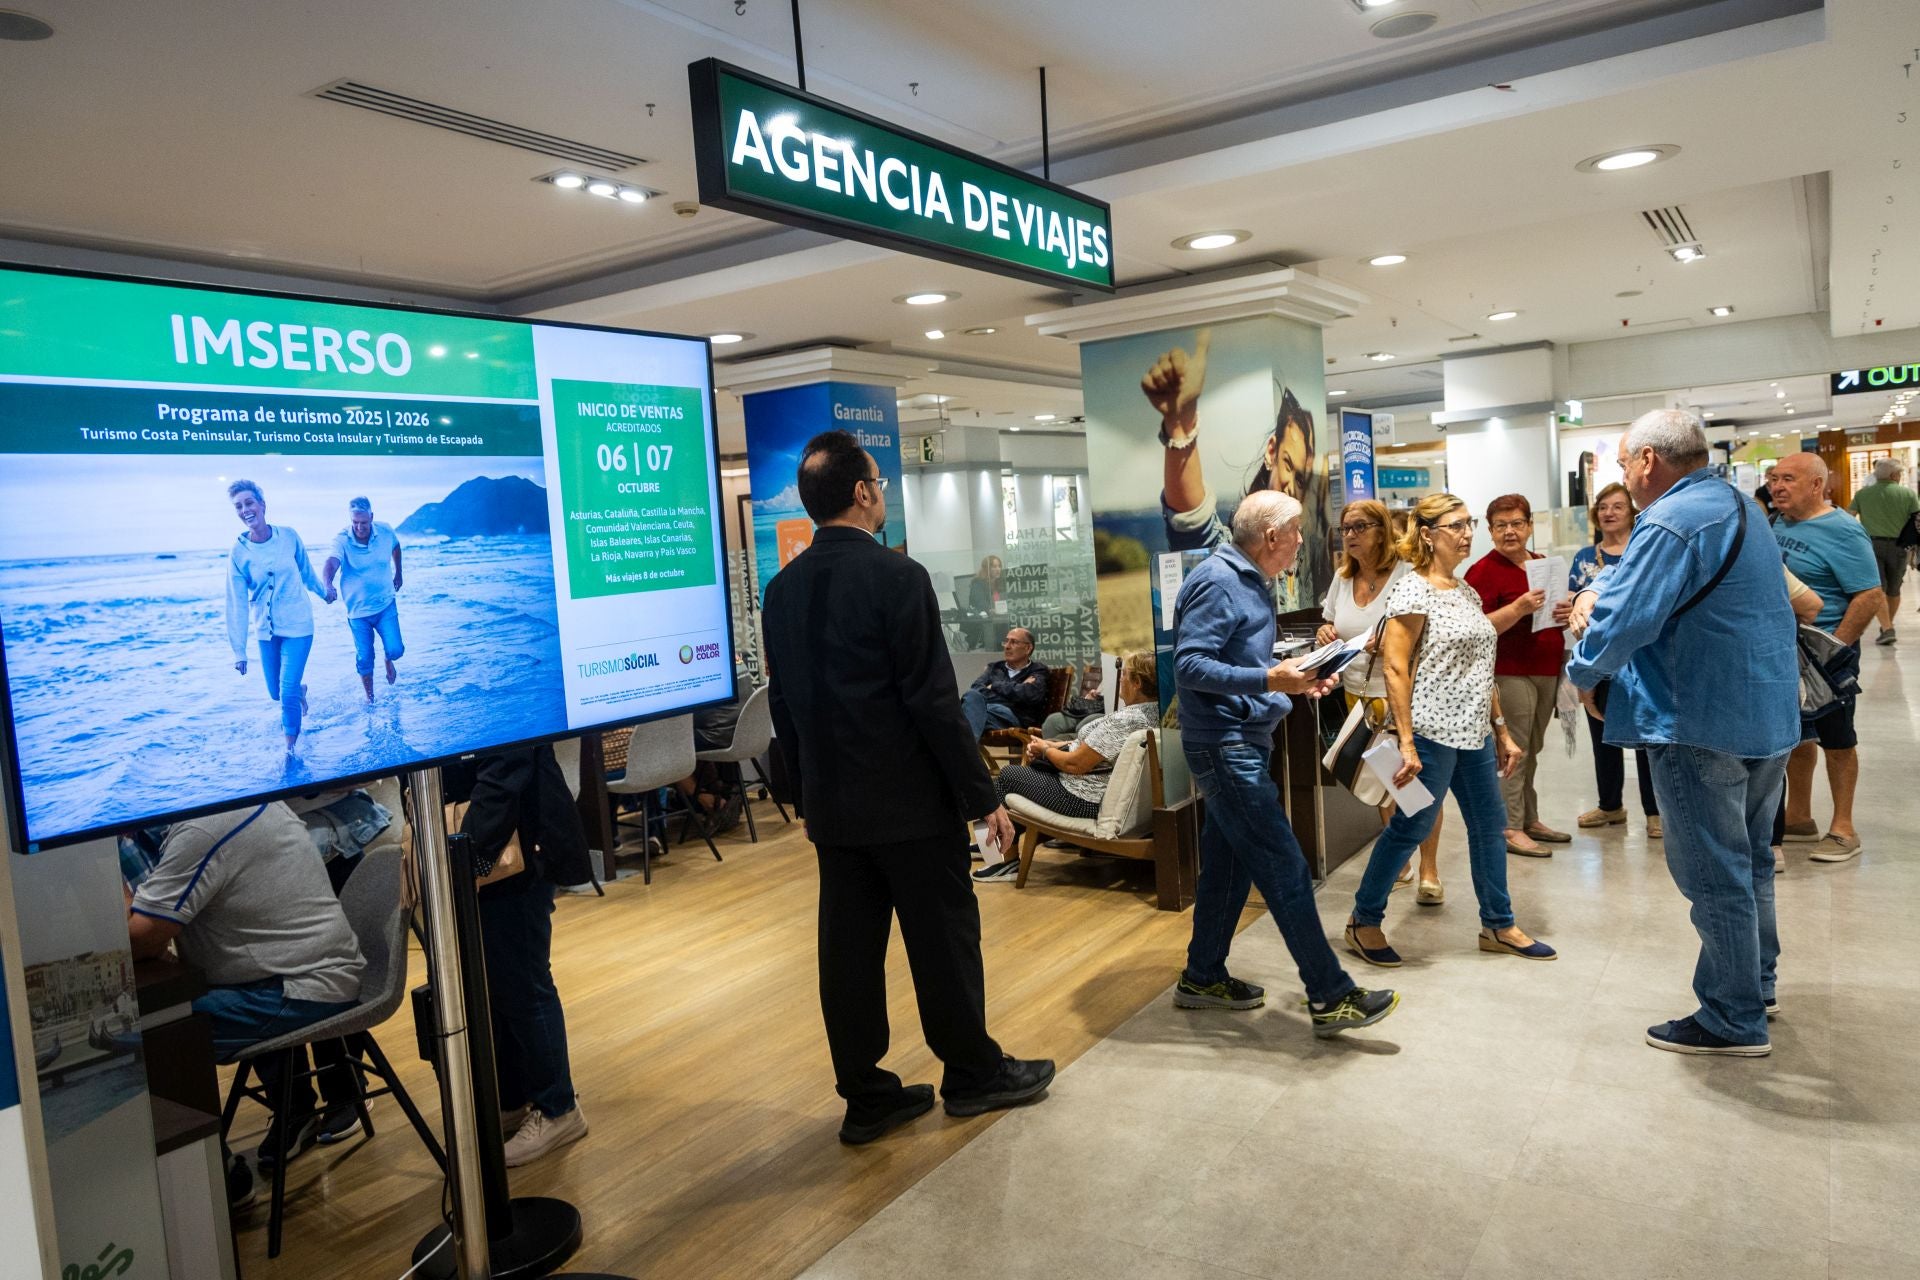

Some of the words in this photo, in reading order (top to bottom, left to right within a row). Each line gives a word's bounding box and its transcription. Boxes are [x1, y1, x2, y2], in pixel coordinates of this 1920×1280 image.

[731, 108, 953, 225] AGENCIA
[962, 181, 1011, 241] DE
[1011, 199, 1110, 270] VIAJES
[170, 313, 413, 377] IMSERSO
[157, 403, 249, 425] Programa
[254, 406, 276, 423] de
[280, 408, 342, 425] turismo
[345, 410, 383, 426] 2025
[395, 411, 430, 427] 2026
[577, 402, 618, 418] INICIO
[620, 404, 637, 418] DE
[639, 405, 684, 420] VENTAS
[606, 422, 662, 433] ACREDITADOS
[80, 427, 138, 441] Turismo
[141, 428, 179, 441] Costa
[182, 429, 251, 443] Peninsular,
[253, 430, 300, 443] Turismo
[303, 432, 334, 443] Costa
[337, 432, 373, 444] Insular
[375, 435, 381, 446] y
[384, 433, 424, 445] Turismo
[426, 434, 438, 445] de
[440, 435, 484, 447] Escapada
[851, 428, 891, 448] fianza
[596, 443, 628, 472] 06
[646, 444, 673, 471] 07
[617, 482, 660, 494] OCTUBRE
[570, 510, 604, 521] Asturias,
[604, 508, 640, 520] Cataluña,
[641, 507, 668, 518] Castilla
[677, 505, 706, 516] Mancha,
[586, 522, 630, 534] Comunidad
[631, 521, 672, 532] Valenciana,
[673, 520, 695, 530] Ceuta,
[590, 538, 608, 548] Islas
[609, 537, 643, 547] Baleares,
[644, 535, 660, 545] Islas
[661, 533, 693, 544] Canarias,
[591, 552, 600, 562] La
[601, 551, 623, 562] Rioja,
[624, 549, 653, 560] Navarra
[655, 550, 660, 558] y
[676, 547, 697, 556] Vasco
[605, 573, 620, 584] Más
[621, 572, 642, 583] viajes
[643, 571, 648, 579] 8
[649, 570, 658, 579] de
[659, 568, 685, 579] octubre
[696, 643, 719, 653] MUNDI
[696, 651, 720, 660] COLOR
